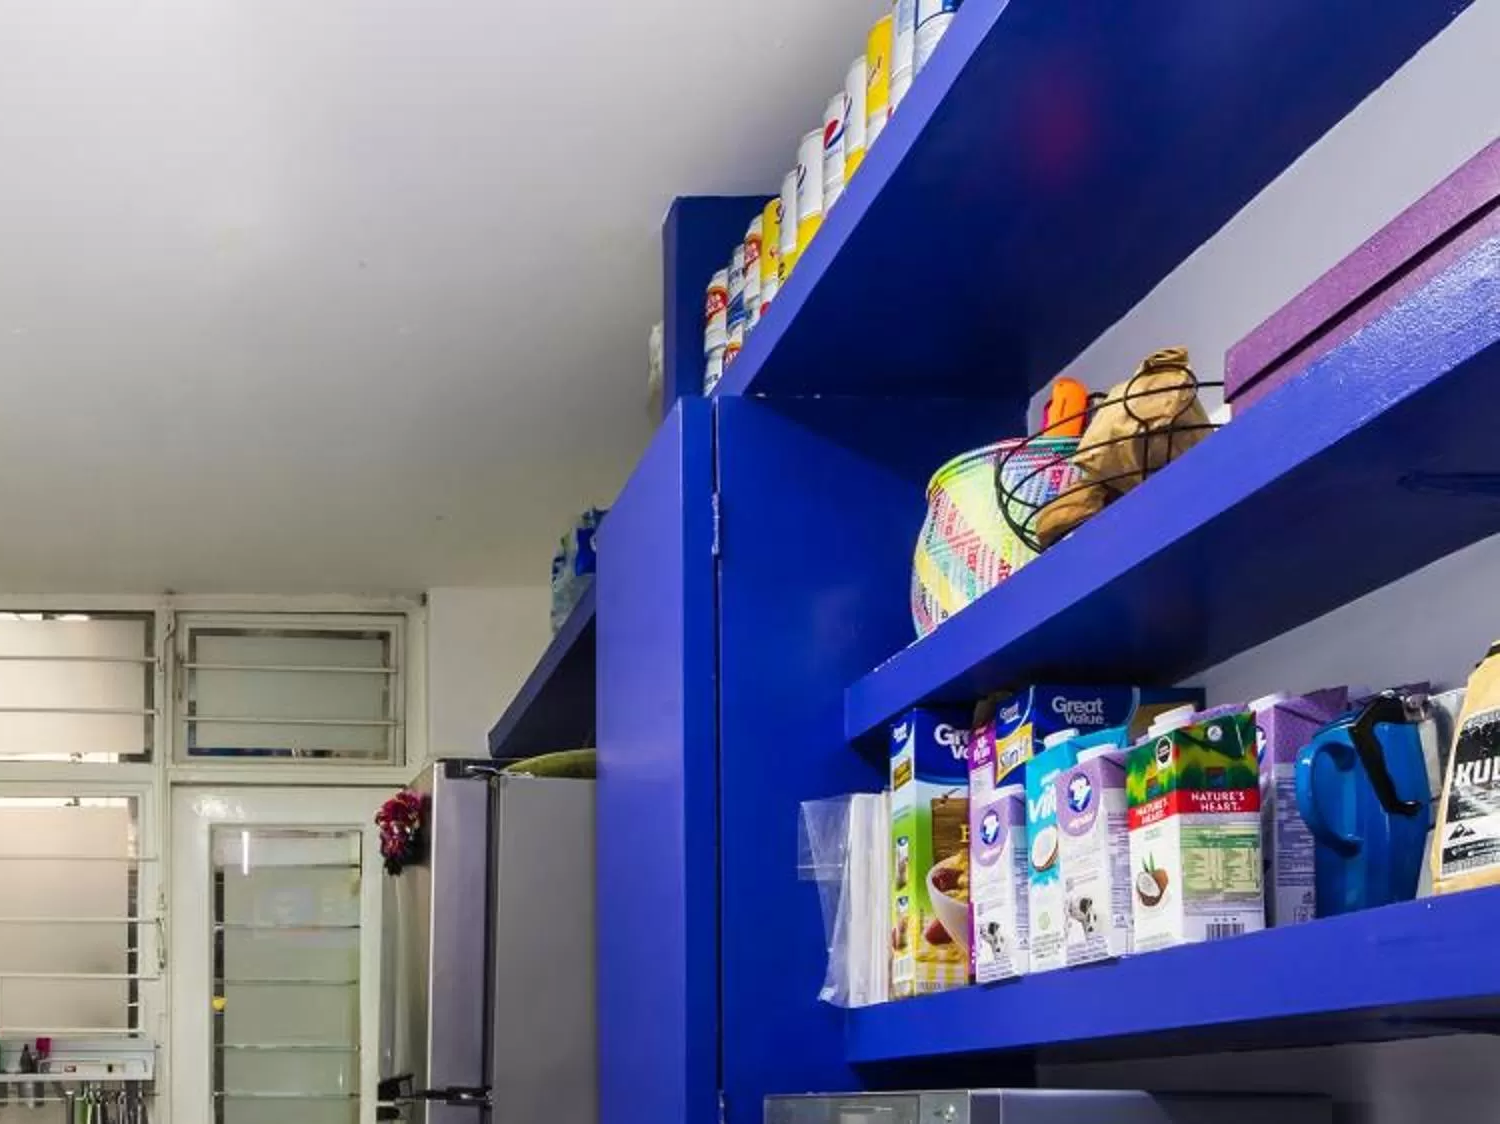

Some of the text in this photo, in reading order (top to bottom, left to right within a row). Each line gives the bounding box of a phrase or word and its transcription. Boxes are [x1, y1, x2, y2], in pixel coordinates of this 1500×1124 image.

[1052, 696, 1104, 714] Great
[1064, 713, 1105, 725] Value
[934, 723, 970, 746] Gre
[1191, 791, 1246, 802] NATURE'S
